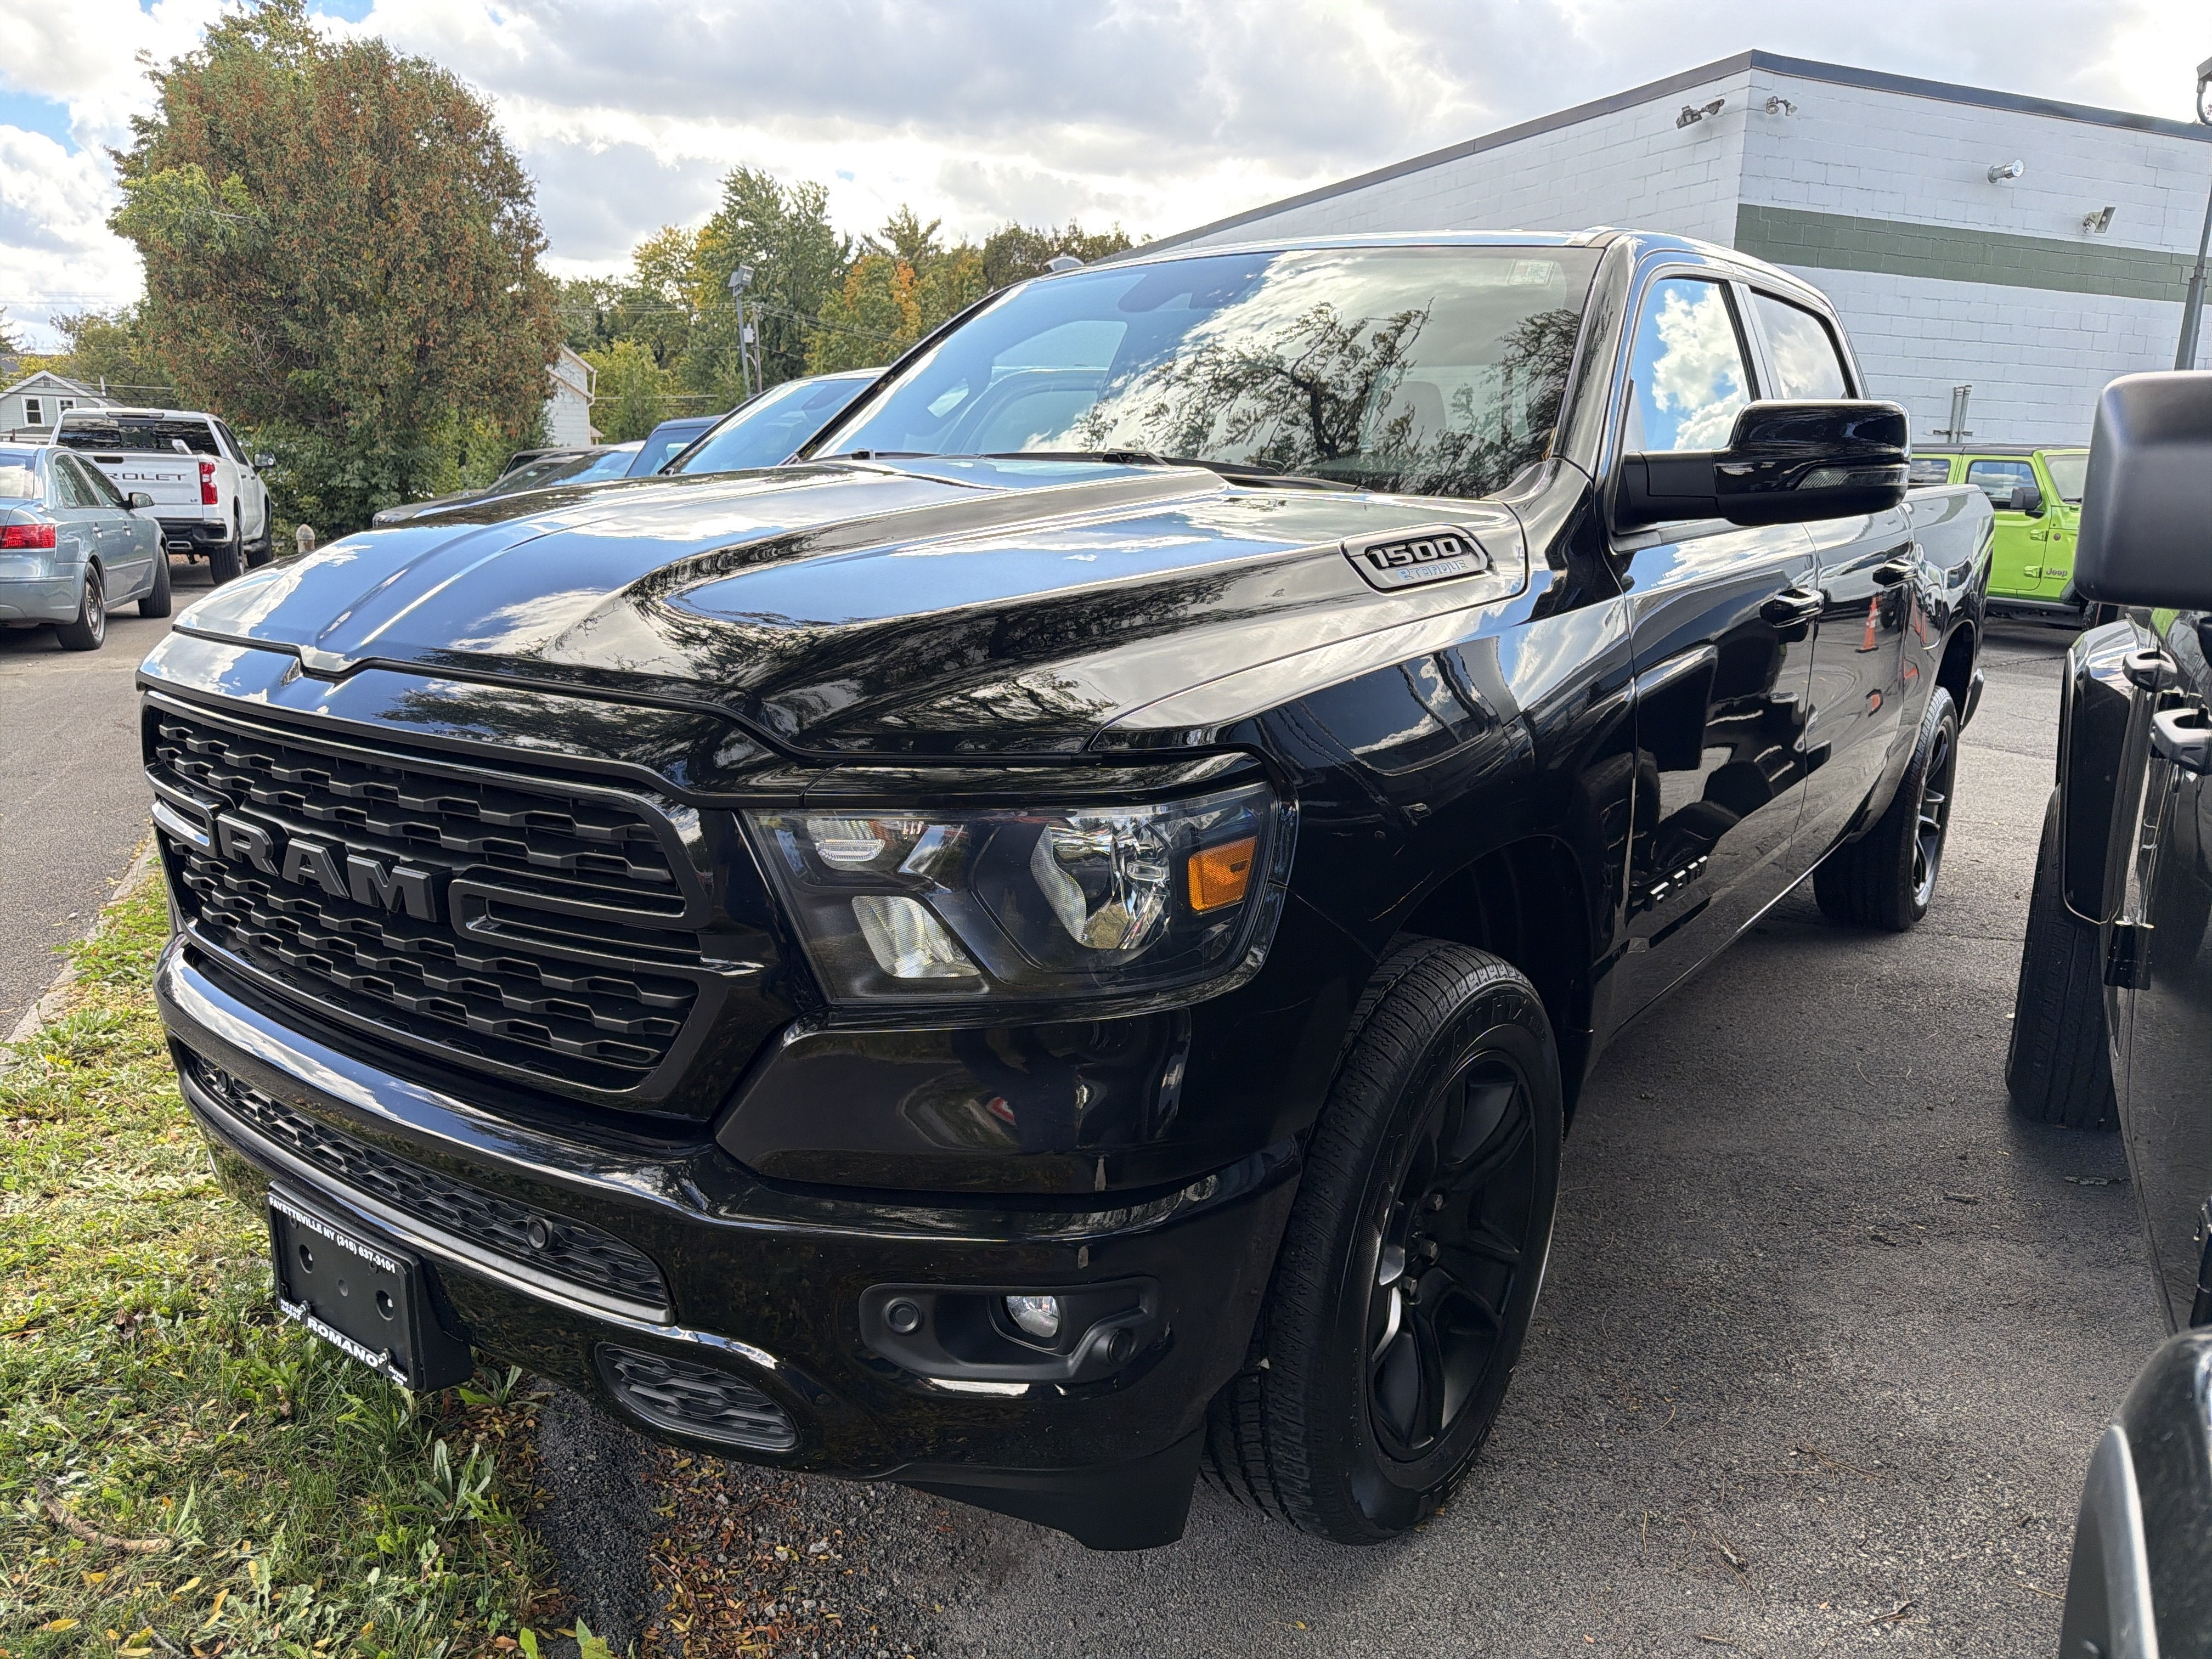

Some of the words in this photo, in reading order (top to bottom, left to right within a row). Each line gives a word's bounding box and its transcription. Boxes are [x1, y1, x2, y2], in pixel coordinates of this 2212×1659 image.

[104, 473, 187, 481] ROLET
[1368, 537, 1462, 567] 1500
[2045, 567, 2068, 577] Jeep
[217, 812, 438, 923] RAM
[269, 1196, 323, 1234] FAYETTEVILLE
[323, 1227, 335, 1240] NY
[358, 1246, 395, 1273] 637-3101
[308, 1317, 379, 1367] ROMANO
